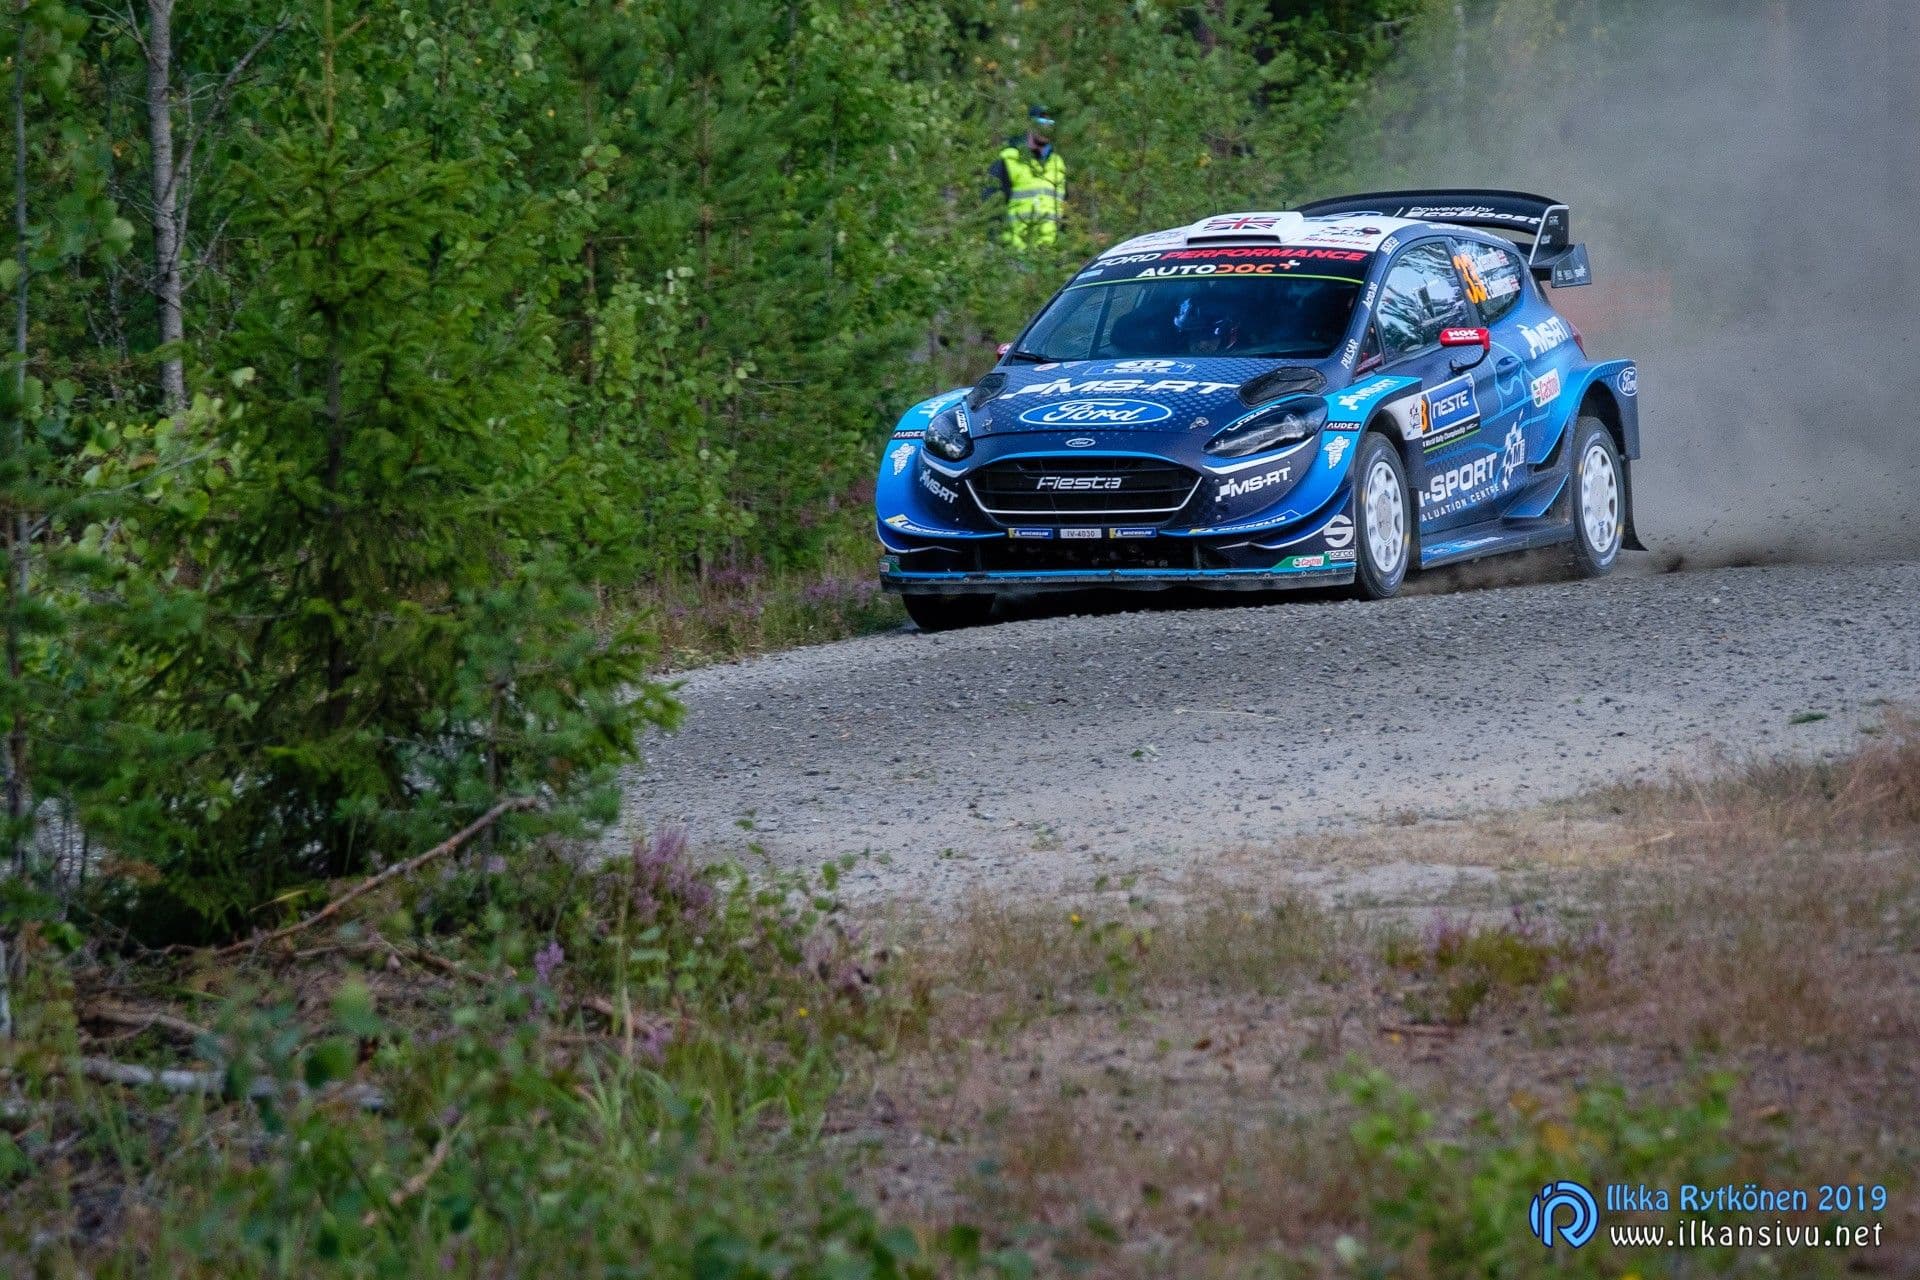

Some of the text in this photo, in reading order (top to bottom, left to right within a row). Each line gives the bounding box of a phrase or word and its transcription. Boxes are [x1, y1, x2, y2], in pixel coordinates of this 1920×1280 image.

[1404, 211, 1543, 224] EcoBoost
[1090, 247, 1368, 269] FORD PERFORMANCE
[1136, 262, 1277, 278] AUTODOC
[1340, 338, 1359, 369] PULSAR
[1040, 400, 1148, 422] Ford
[1433, 390, 1469, 419] NESTE
[1036, 476, 1122, 489] Fiesta
[1224, 467, 1291, 499] MS-RT
[1421, 484, 1500, 522] ALUATION CENTRE
